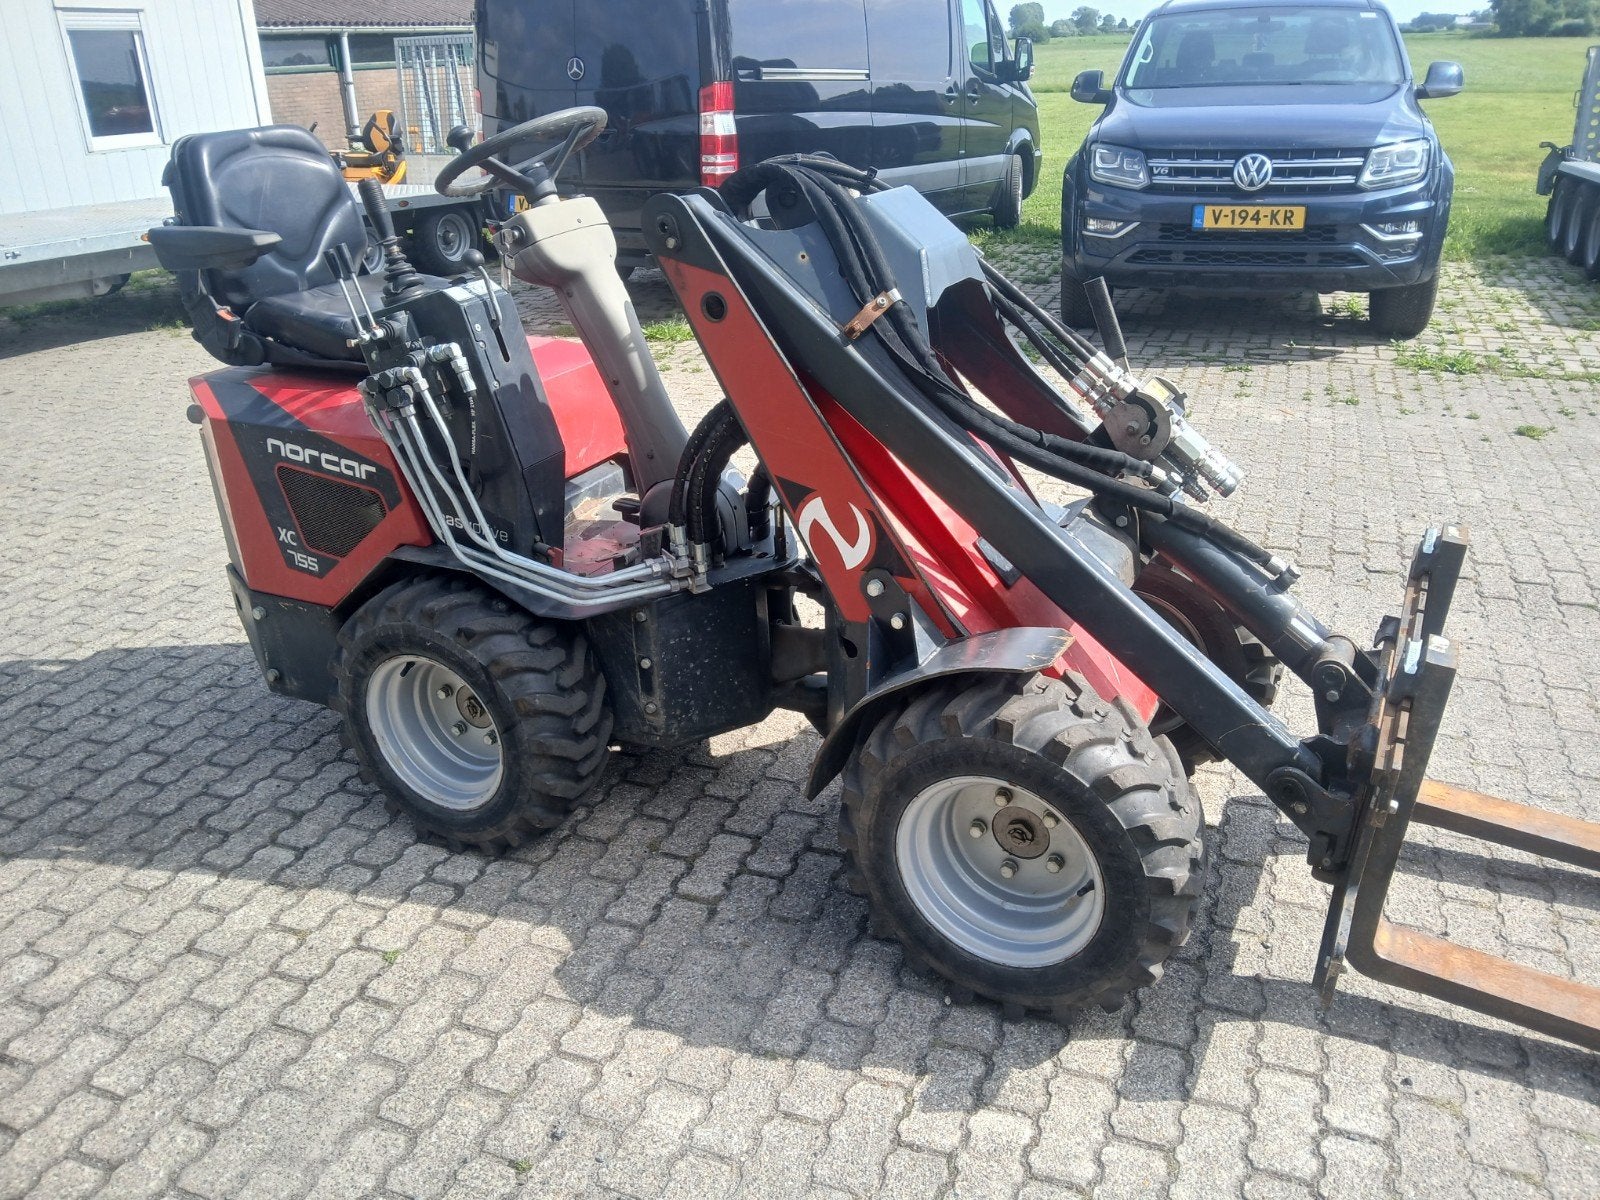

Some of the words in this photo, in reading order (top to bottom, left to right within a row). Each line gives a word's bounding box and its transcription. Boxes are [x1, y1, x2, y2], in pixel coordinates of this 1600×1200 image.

[1152, 166, 1169, 175] V6
[1212, 209, 1295, 226] V-194-KR
[266, 437, 377, 480] norcar
[277, 526, 298, 546] XC
[286, 549, 320, 572] 755
